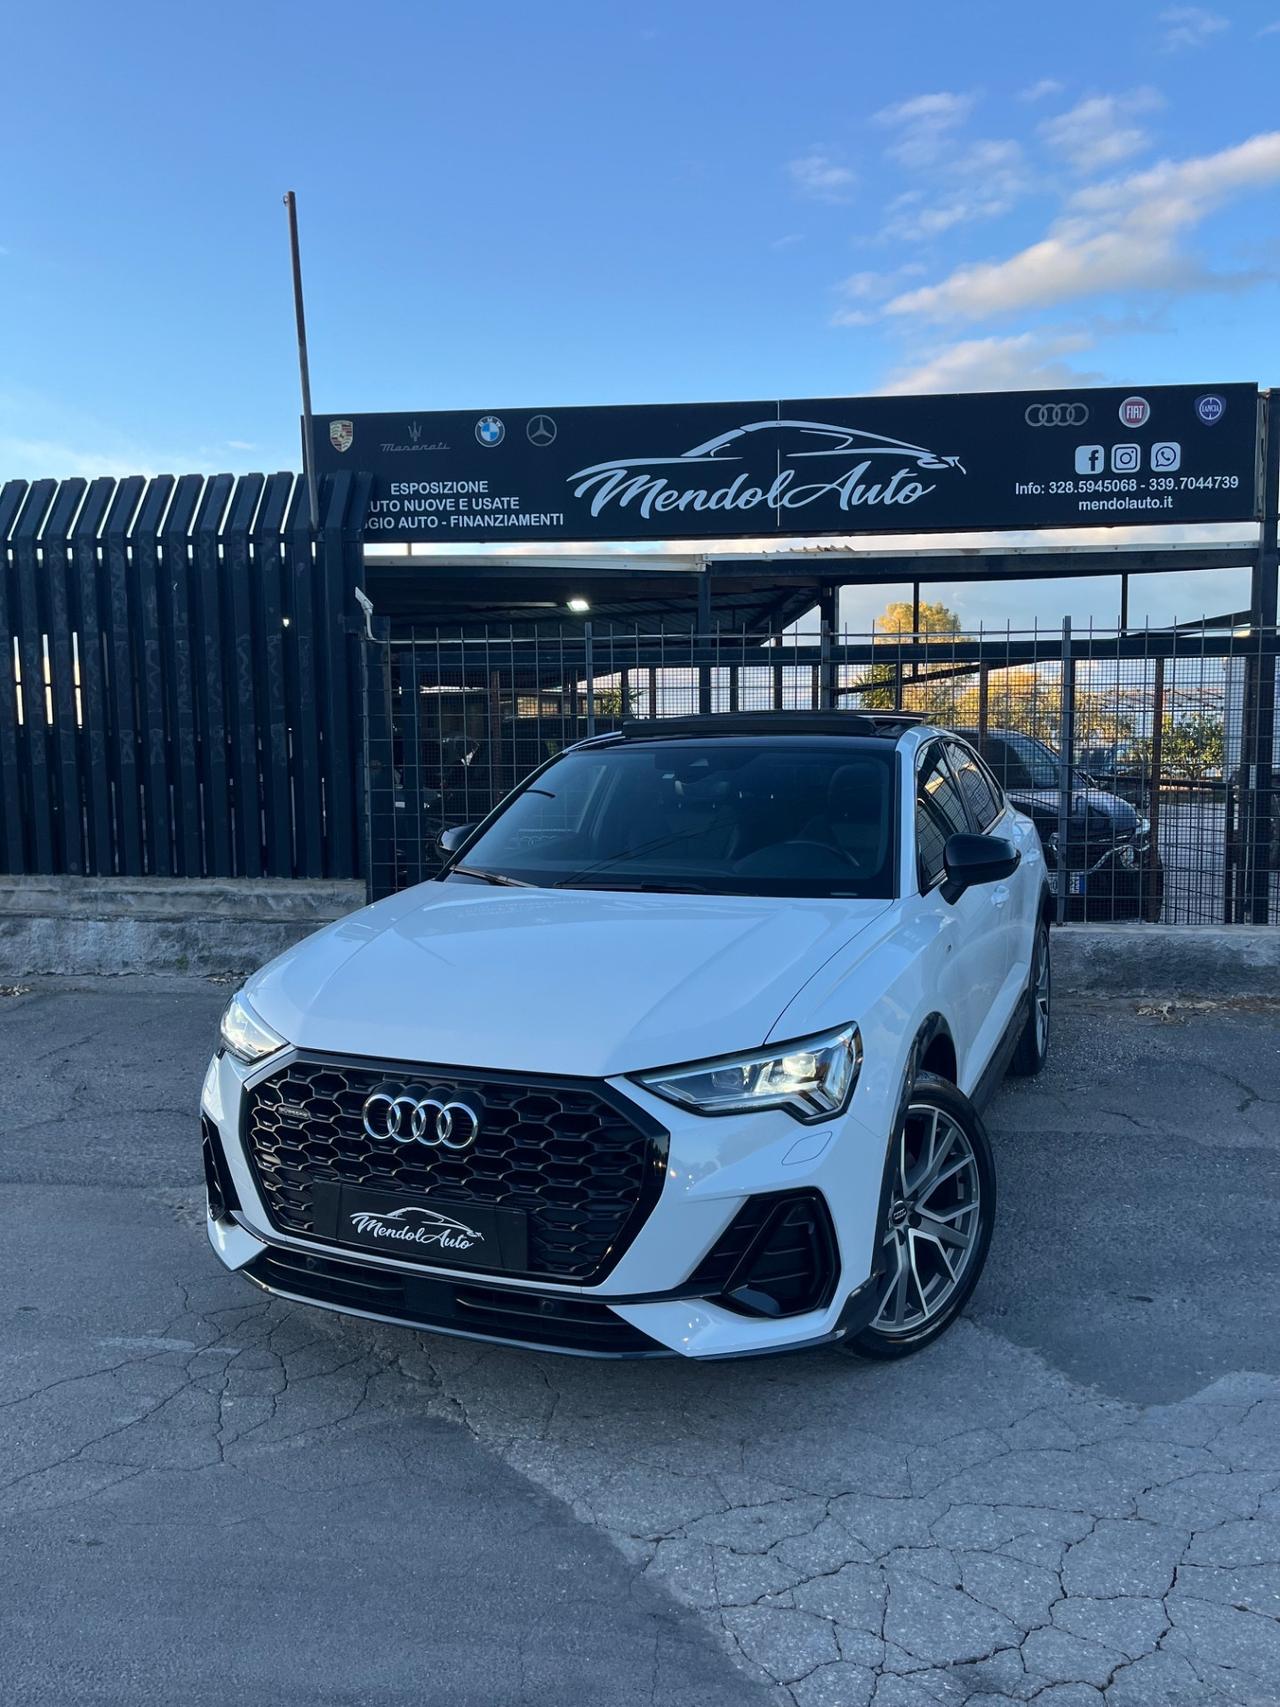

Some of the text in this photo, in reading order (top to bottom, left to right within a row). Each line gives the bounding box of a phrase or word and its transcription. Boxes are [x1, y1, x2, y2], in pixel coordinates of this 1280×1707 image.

[1126, 405, 1144, 420] FIAT
[380, 442, 451, 452] Maserati
[390, 480, 489, 495] ESPOSIZIONE
[1015, 482, 1046, 495] Info:
[1048, 478, 1137, 494] 328.5945068
[1149, 475, 1240, 491] 339.7044739
[368, 496, 520, 513] UTO NUOVE E USATE
[1078, 496, 1173, 511] mendolauto.it
[365, 516, 395, 530] GIO
[398, 515, 439, 529] AUTO
[450, 513, 564, 529] FINANZIAMENTI
